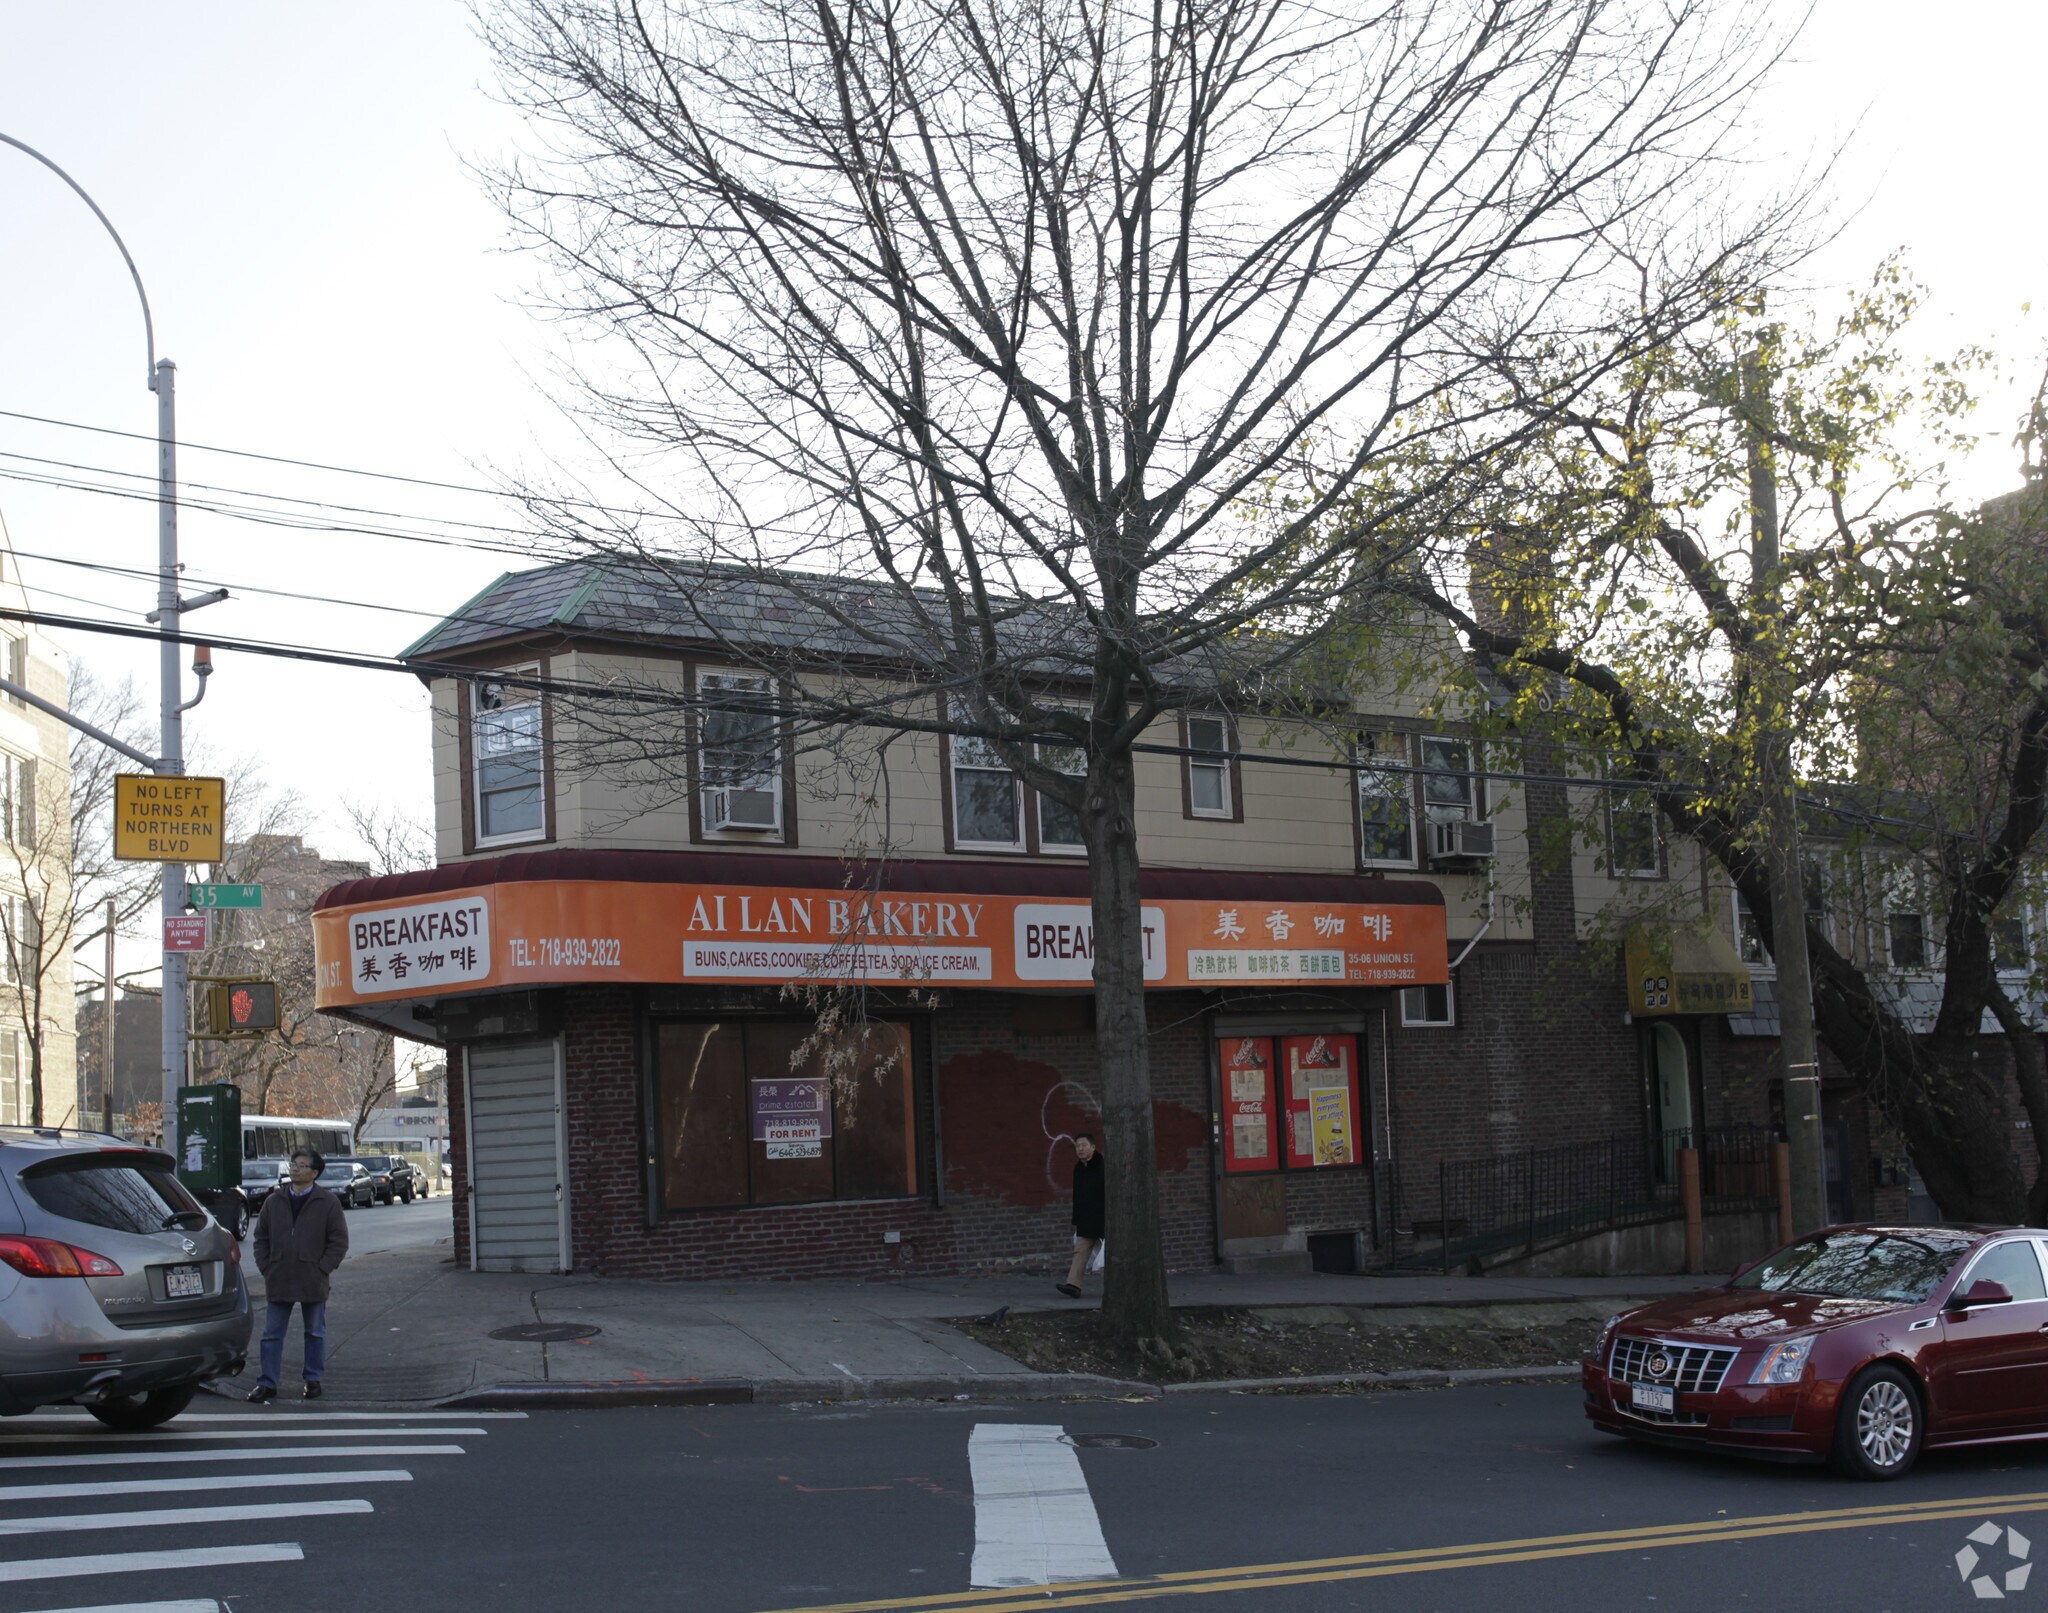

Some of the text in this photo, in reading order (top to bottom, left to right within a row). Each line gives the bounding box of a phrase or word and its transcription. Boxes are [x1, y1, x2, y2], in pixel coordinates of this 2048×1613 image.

[137, 786, 202, 800] NO LEFT
[130, 803, 208, 818] TURNS AT
[126, 820, 212, 835] NORTHERN
[149, 839, 189, 852] BLVD
[196, 886, 254, 906] 35 AV
[166, 920, 204, 928] NO STANDING
[688, 895, 984, 938] AI LAN BAKERY
[355, 908, 482, 950] BREAKFAST
[1213, 909, 1393, 942] 美香咖啡
[1026, 924, 1155, 960] BREAT
[509, 938, 621, 966] TEL: 718-939-2822
[1348, 953, 1416, 964] 35-06 UNION ST.
[358, 946, 476, 982] 美香咖啡
[330, 961, 342, 988] ST.
[1368, 969, 1416, 980] 718-939-2822
[759, 1100, 816, 1110] prime estates
[770, 1129, 816, 1138] FOR RENT
